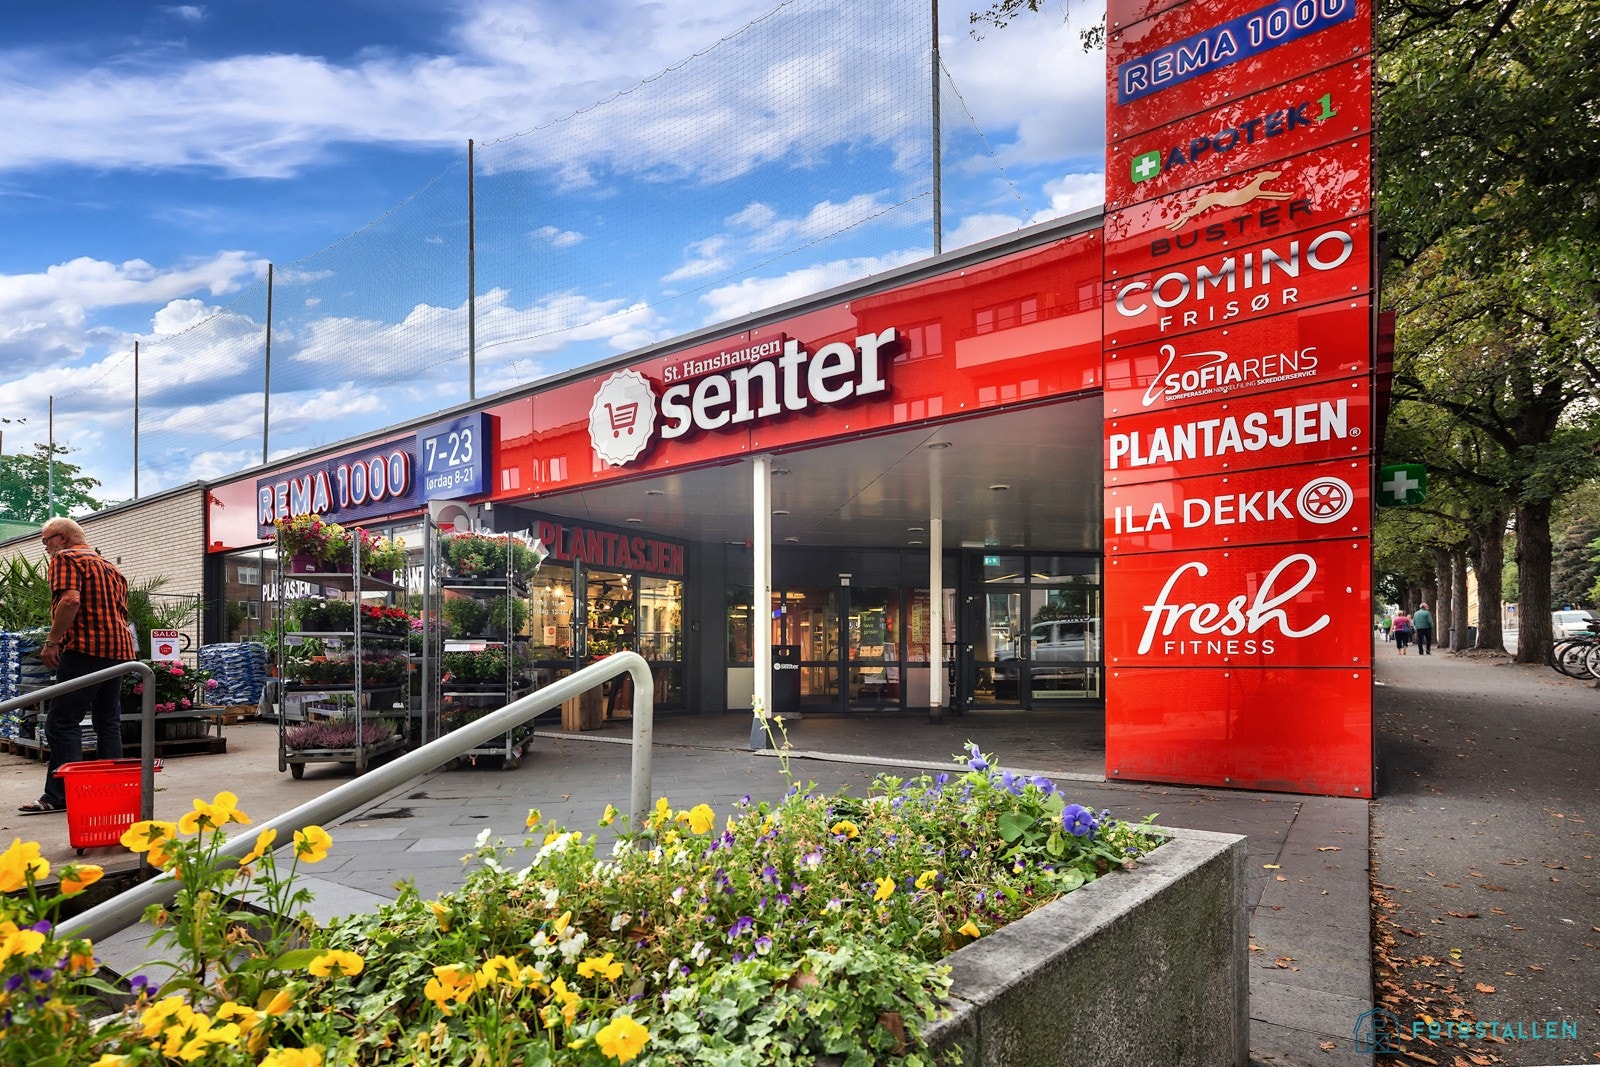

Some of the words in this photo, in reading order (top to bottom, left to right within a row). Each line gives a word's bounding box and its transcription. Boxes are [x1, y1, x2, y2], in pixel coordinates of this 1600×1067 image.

[1125, 30, 1237, 96] REMA
[1246, 0, 1348, 48] 1000
[1151, 198, 1314, 257] BUSTER
[1115, 230, 1354, 317] COMINO
[1160, 287, 1299, 332] FRISØR
[660, 326, 896, 440] senter
[664, 365, 682, 383] St.
[683, 338, 781, 378] Hanshaugen
[1164, 346, 1319, 395] SOFIARENS
[1256, 369, 1318, 386] SKREDDERSERVICE
[425, 429, 473, 472] 7-23
[258, 470, 334, 527] REMA
[336, 449, 411, 509] 1000
[426, 474, 453, 491] lørdag
[454, 467, 473, 484] 8-21
[1114, 502, 1172, 535] ILA
[536, 519, 685, 577] PLANTASJEN
[262, 580, 312, 602] PLAASJEN
[1137, 553, 1331, 656] fresh
[1164, 639, 1276, 655] FITNESS
